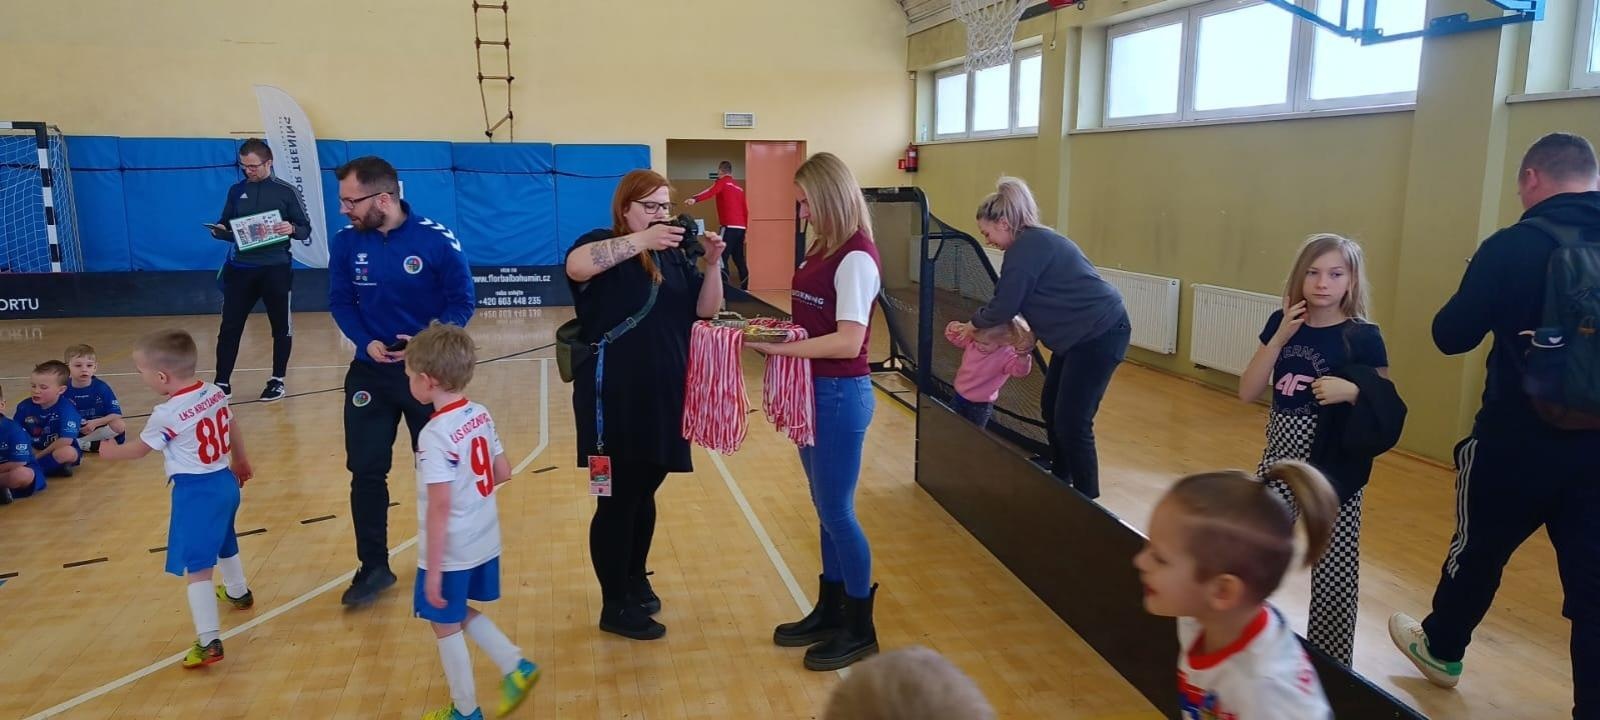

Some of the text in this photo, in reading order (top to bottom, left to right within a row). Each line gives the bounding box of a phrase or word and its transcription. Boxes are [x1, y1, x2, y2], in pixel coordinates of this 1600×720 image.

[479, 297, 497, 305] +420
[528, 296, 541, 304] 235
[179, 408, 195, 421] LKS
[196, 407, 231, 464] 86
[470, 436, 494, 497] 9
